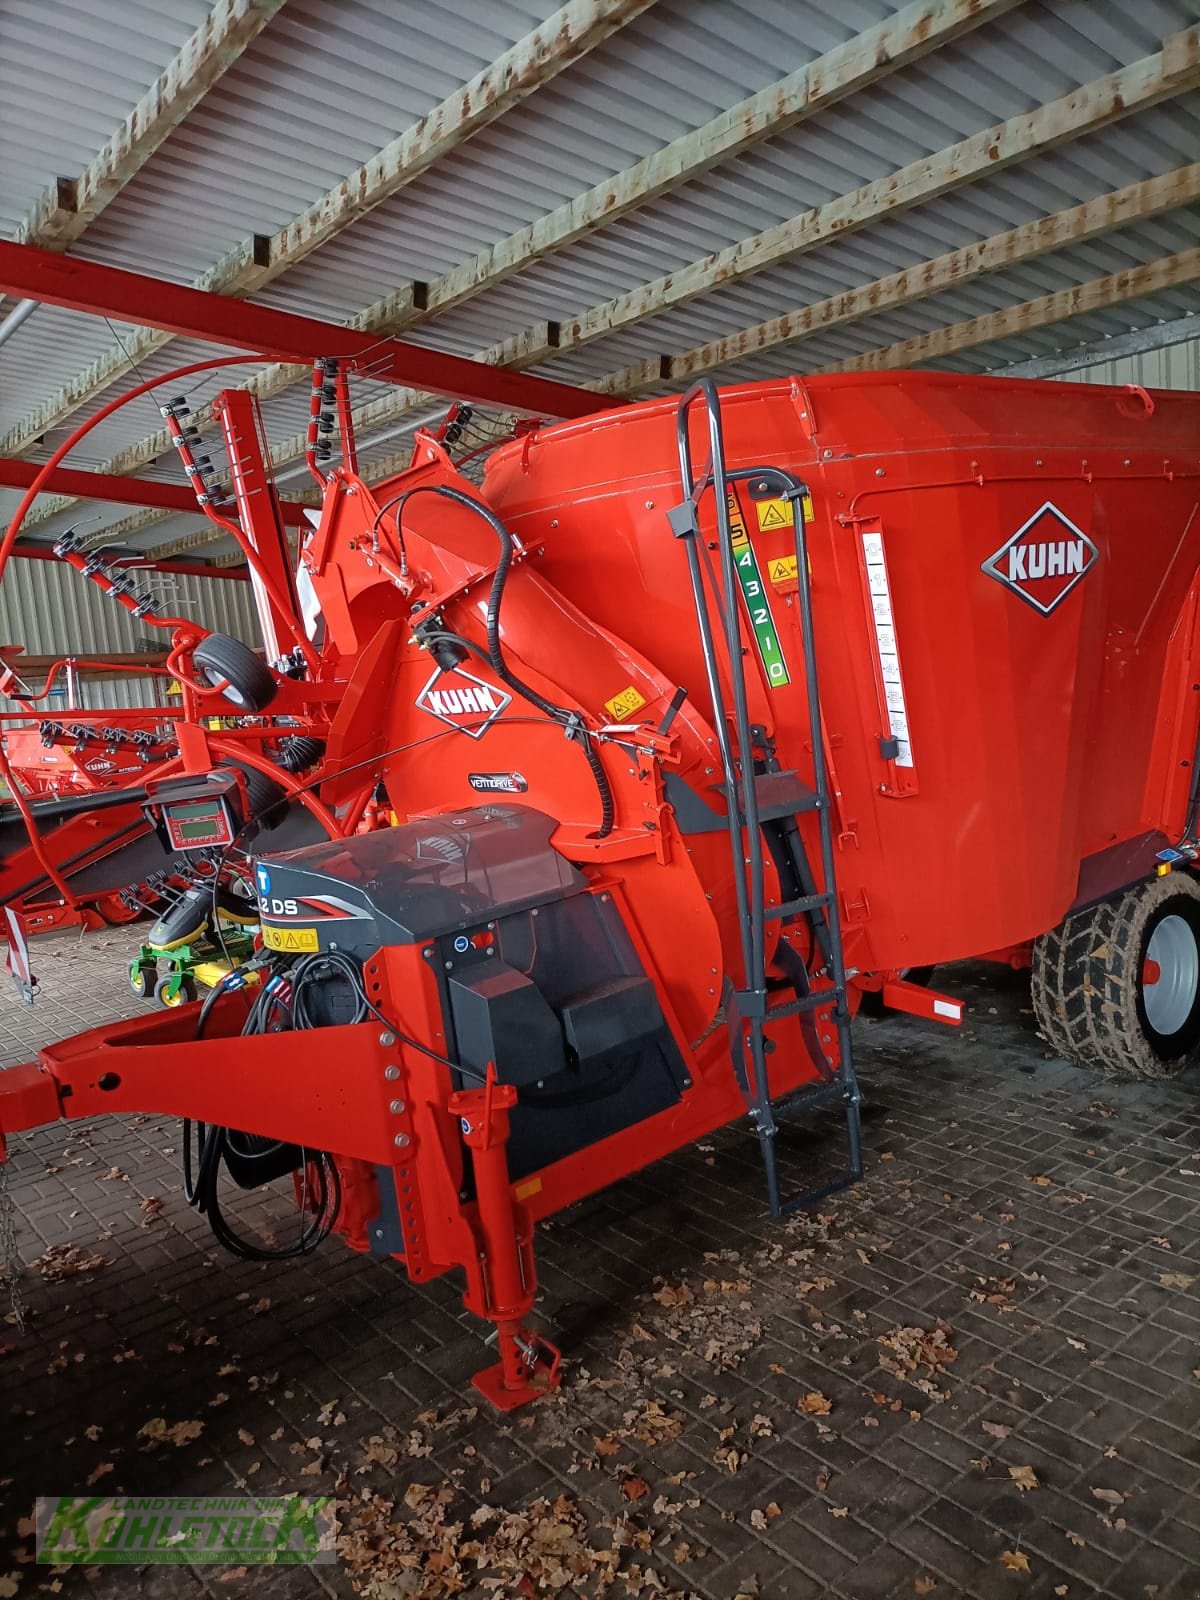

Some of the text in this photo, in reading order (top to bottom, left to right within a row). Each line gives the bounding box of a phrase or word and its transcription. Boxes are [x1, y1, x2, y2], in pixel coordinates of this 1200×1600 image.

[739, 551, 752, 567] 4
[1009, 540, 1084, 581] KUHN
[745, 580, 760, 597] 3
[753, 608, 769, 625] 2
[764, 636, 772, 651] 1
[769, 662, 784, 679] 0
[427, 687, 498, 715] KUHN
[272, 899, 298, 915] DS
